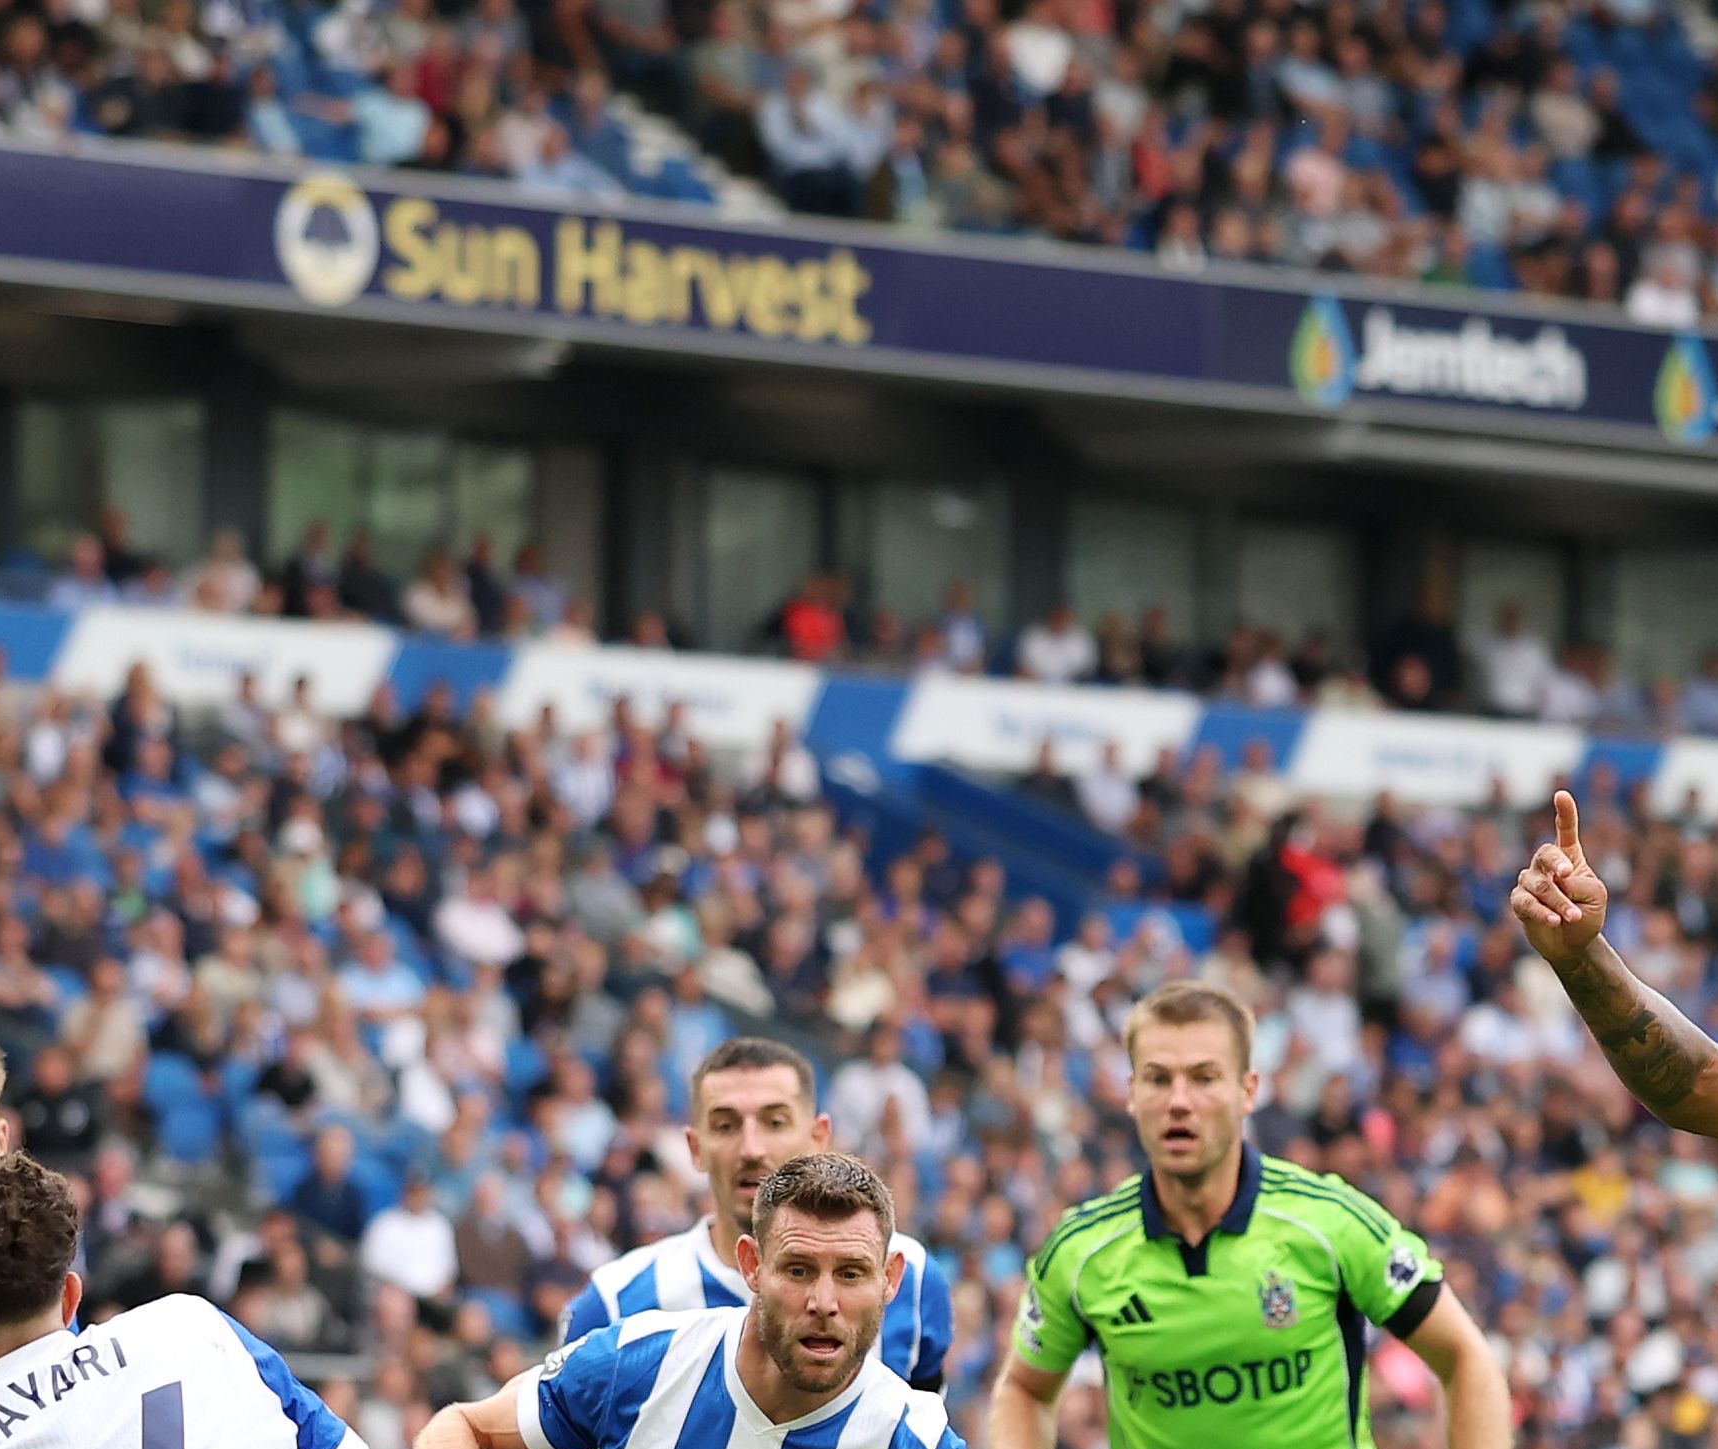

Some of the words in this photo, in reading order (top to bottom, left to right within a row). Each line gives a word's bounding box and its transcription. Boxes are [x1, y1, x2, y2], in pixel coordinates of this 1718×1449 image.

[384, 197, 540, 311] Sun
[553, 215, 872, 347] Harvest
[1151, 1348, 1312, 1410] SBOTOP
